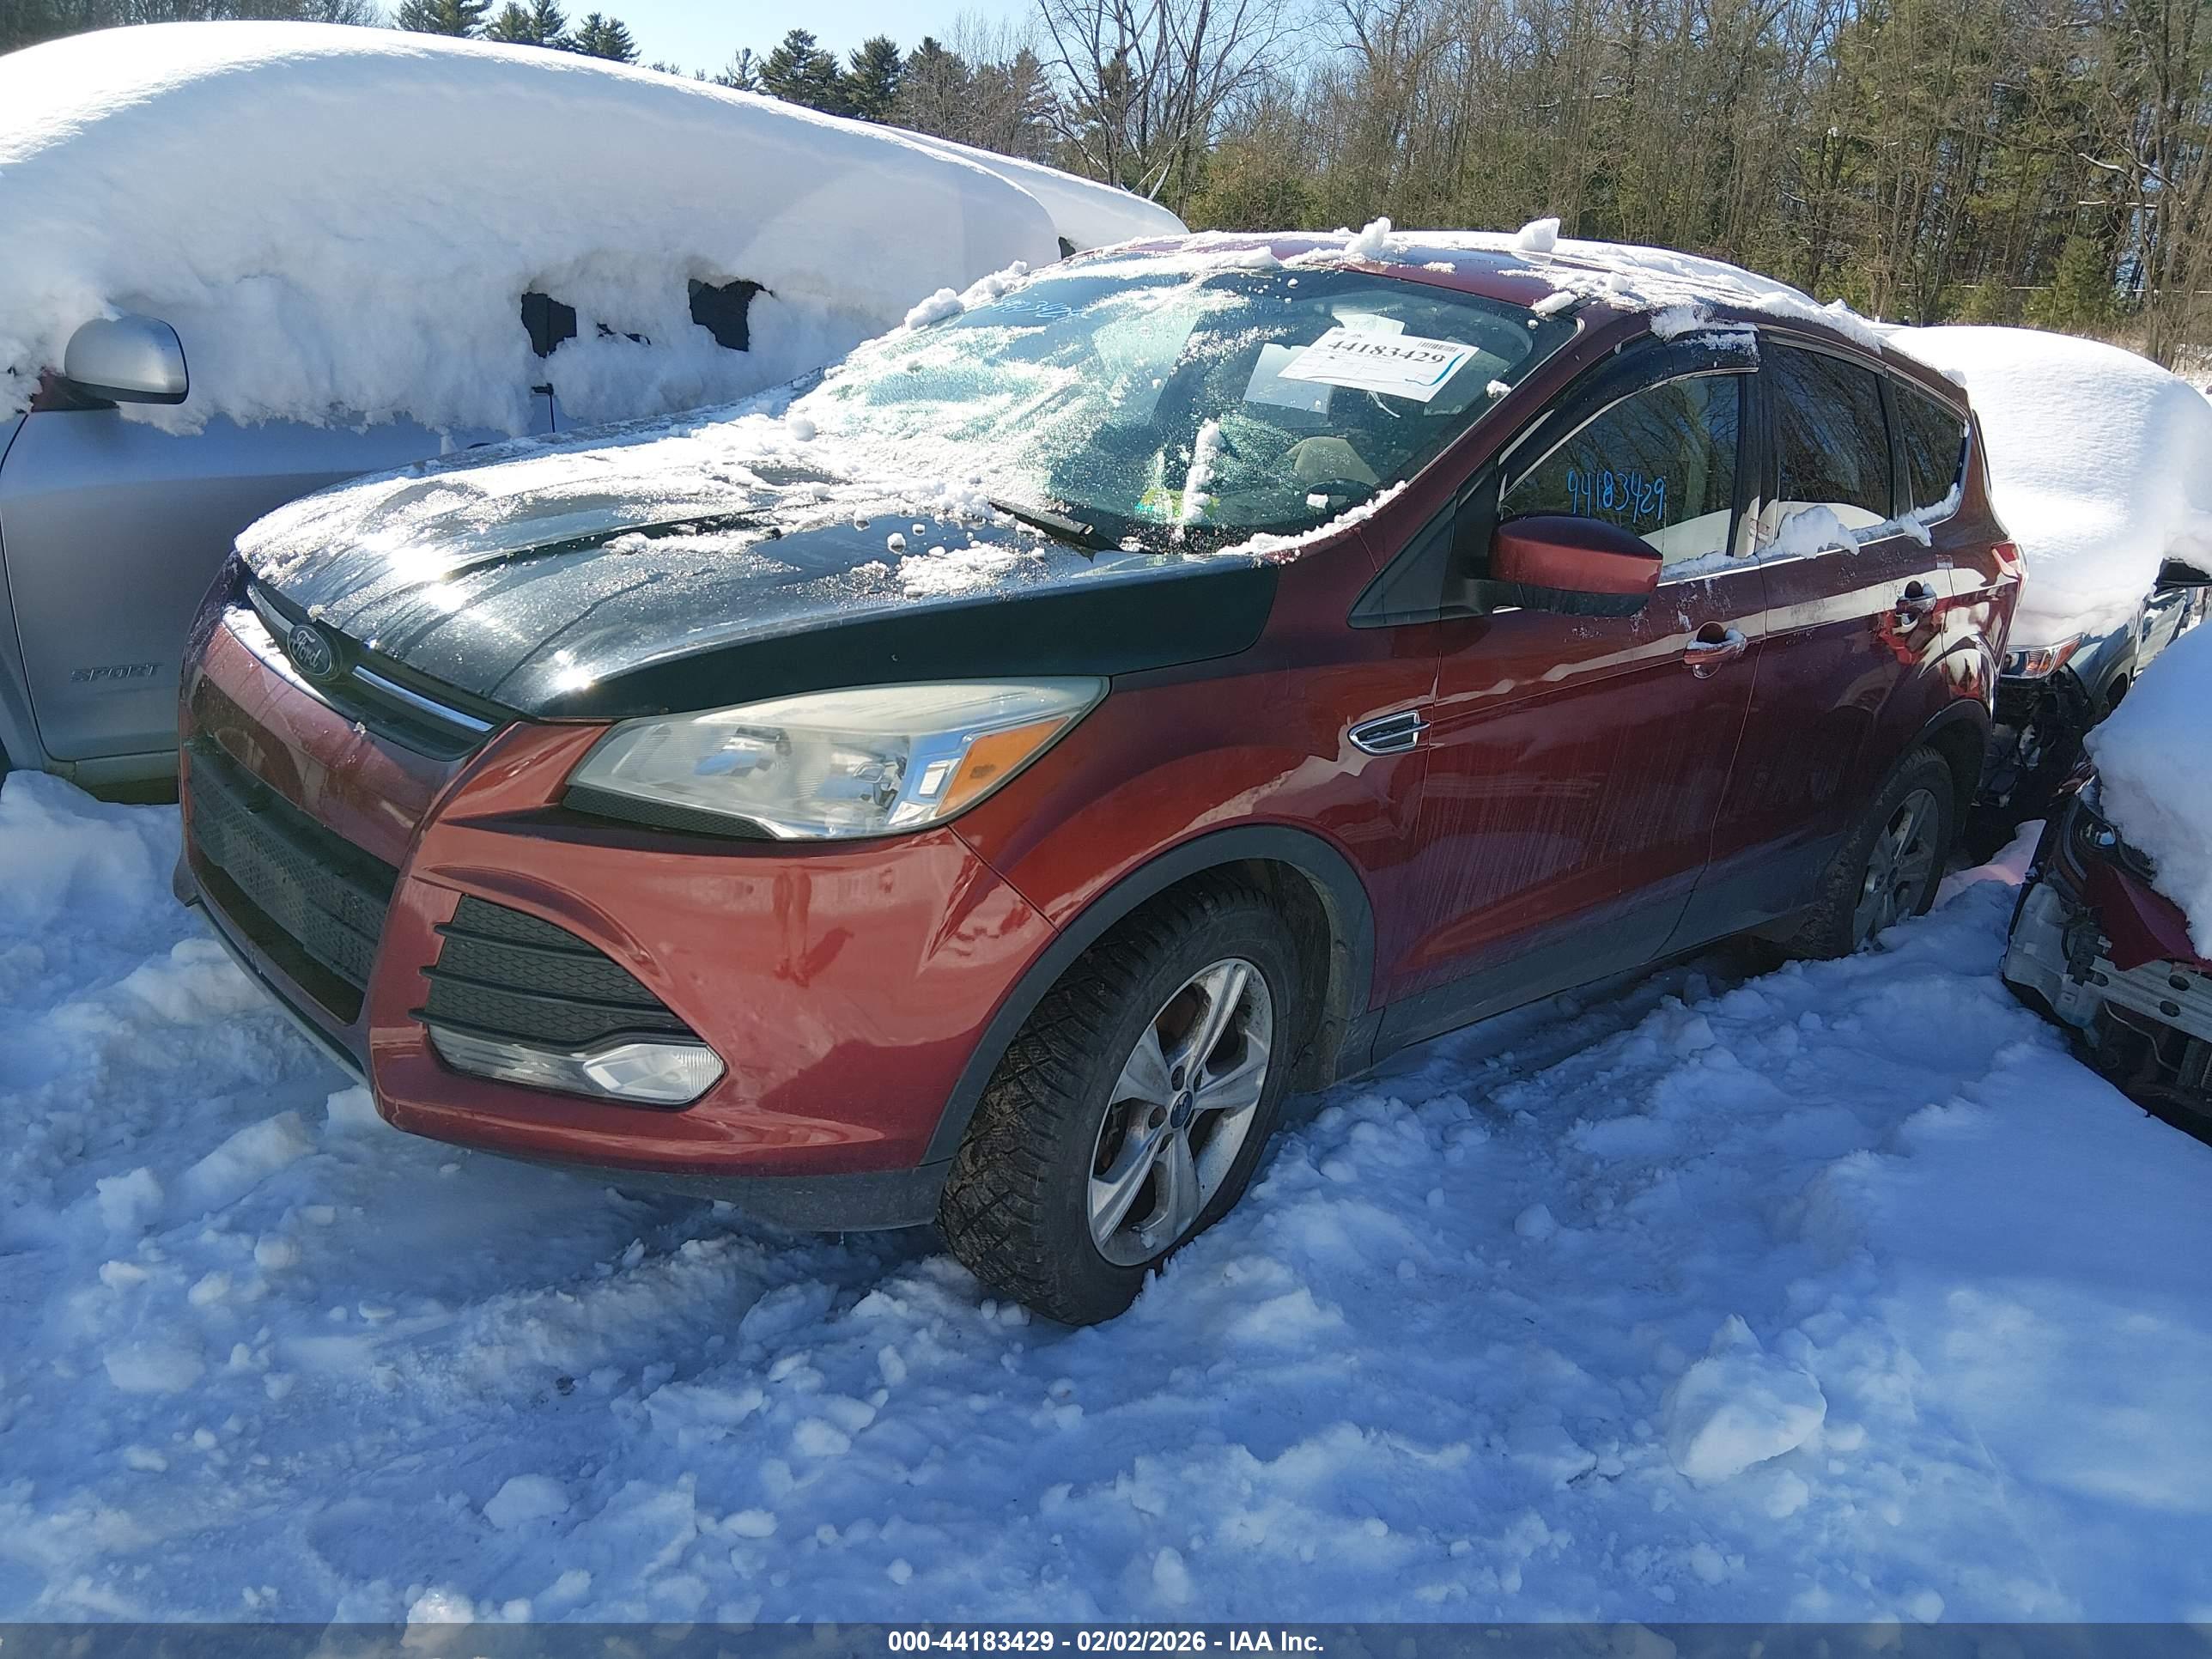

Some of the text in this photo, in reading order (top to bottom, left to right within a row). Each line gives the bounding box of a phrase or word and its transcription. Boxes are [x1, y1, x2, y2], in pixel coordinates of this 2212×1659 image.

[1327, 340, 1446, 364] 44183429
[289, 629, 322, 669] Ford
[70, 662, 165, 682] SPORT
